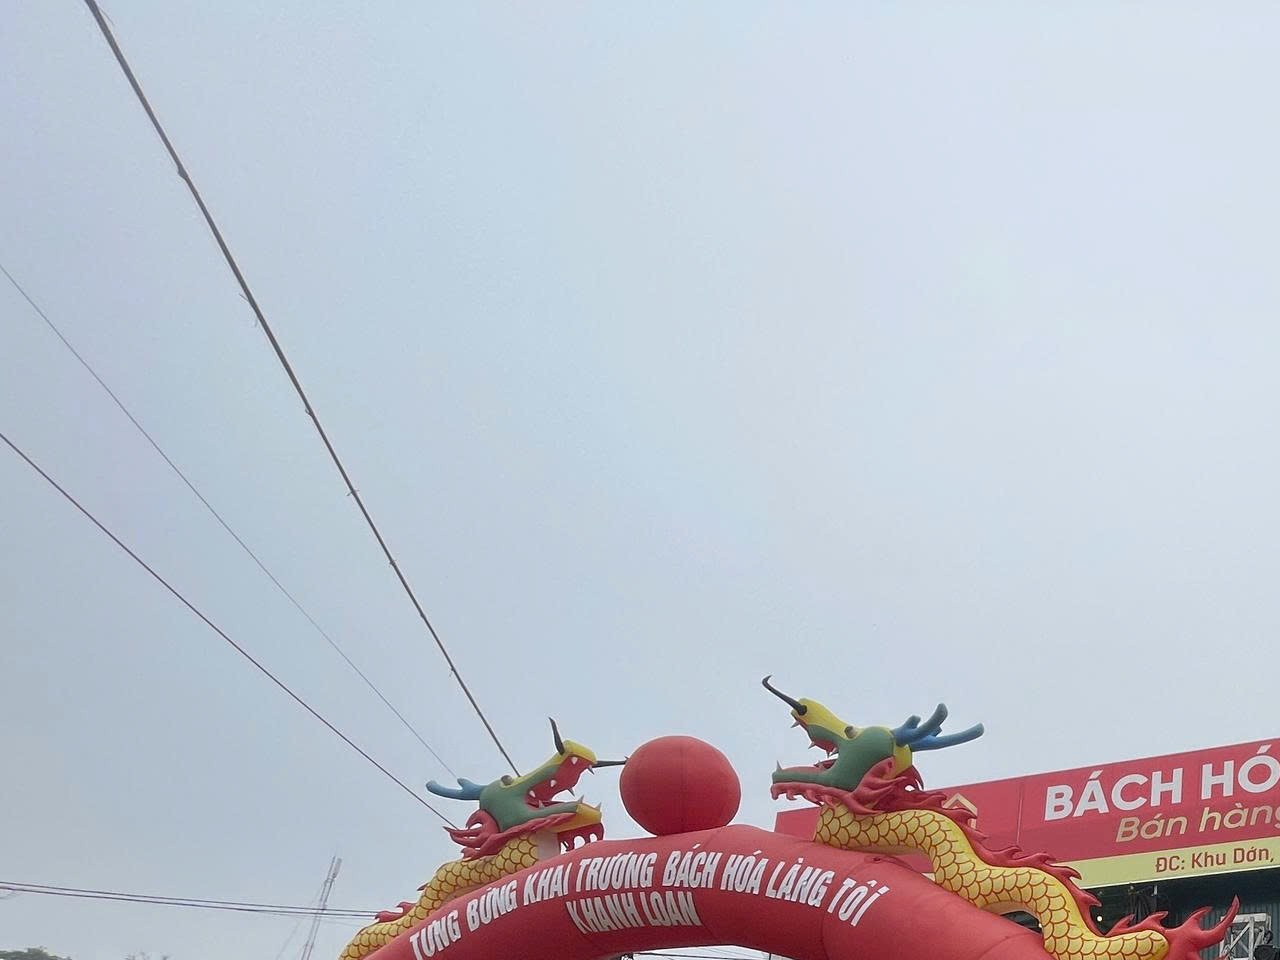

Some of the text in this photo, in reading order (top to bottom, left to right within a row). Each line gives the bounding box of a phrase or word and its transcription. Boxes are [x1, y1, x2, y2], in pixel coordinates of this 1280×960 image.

[1044, 769, 1184, 822] BÁCH
[1115, 812, 1188, 843] Bán
[523, 862, 573, 906] KHAI
[661, 843, 723, 889] BÁCH
[720, 849, 770, 895] HÓA
[1155, 855, 1186, 873] ĐC:
[1191, 851, 1227, 869] Khu
[1233, 845, 1275, 863] Dớn,
[565, 890, 703, 935] KHANH LOAN
